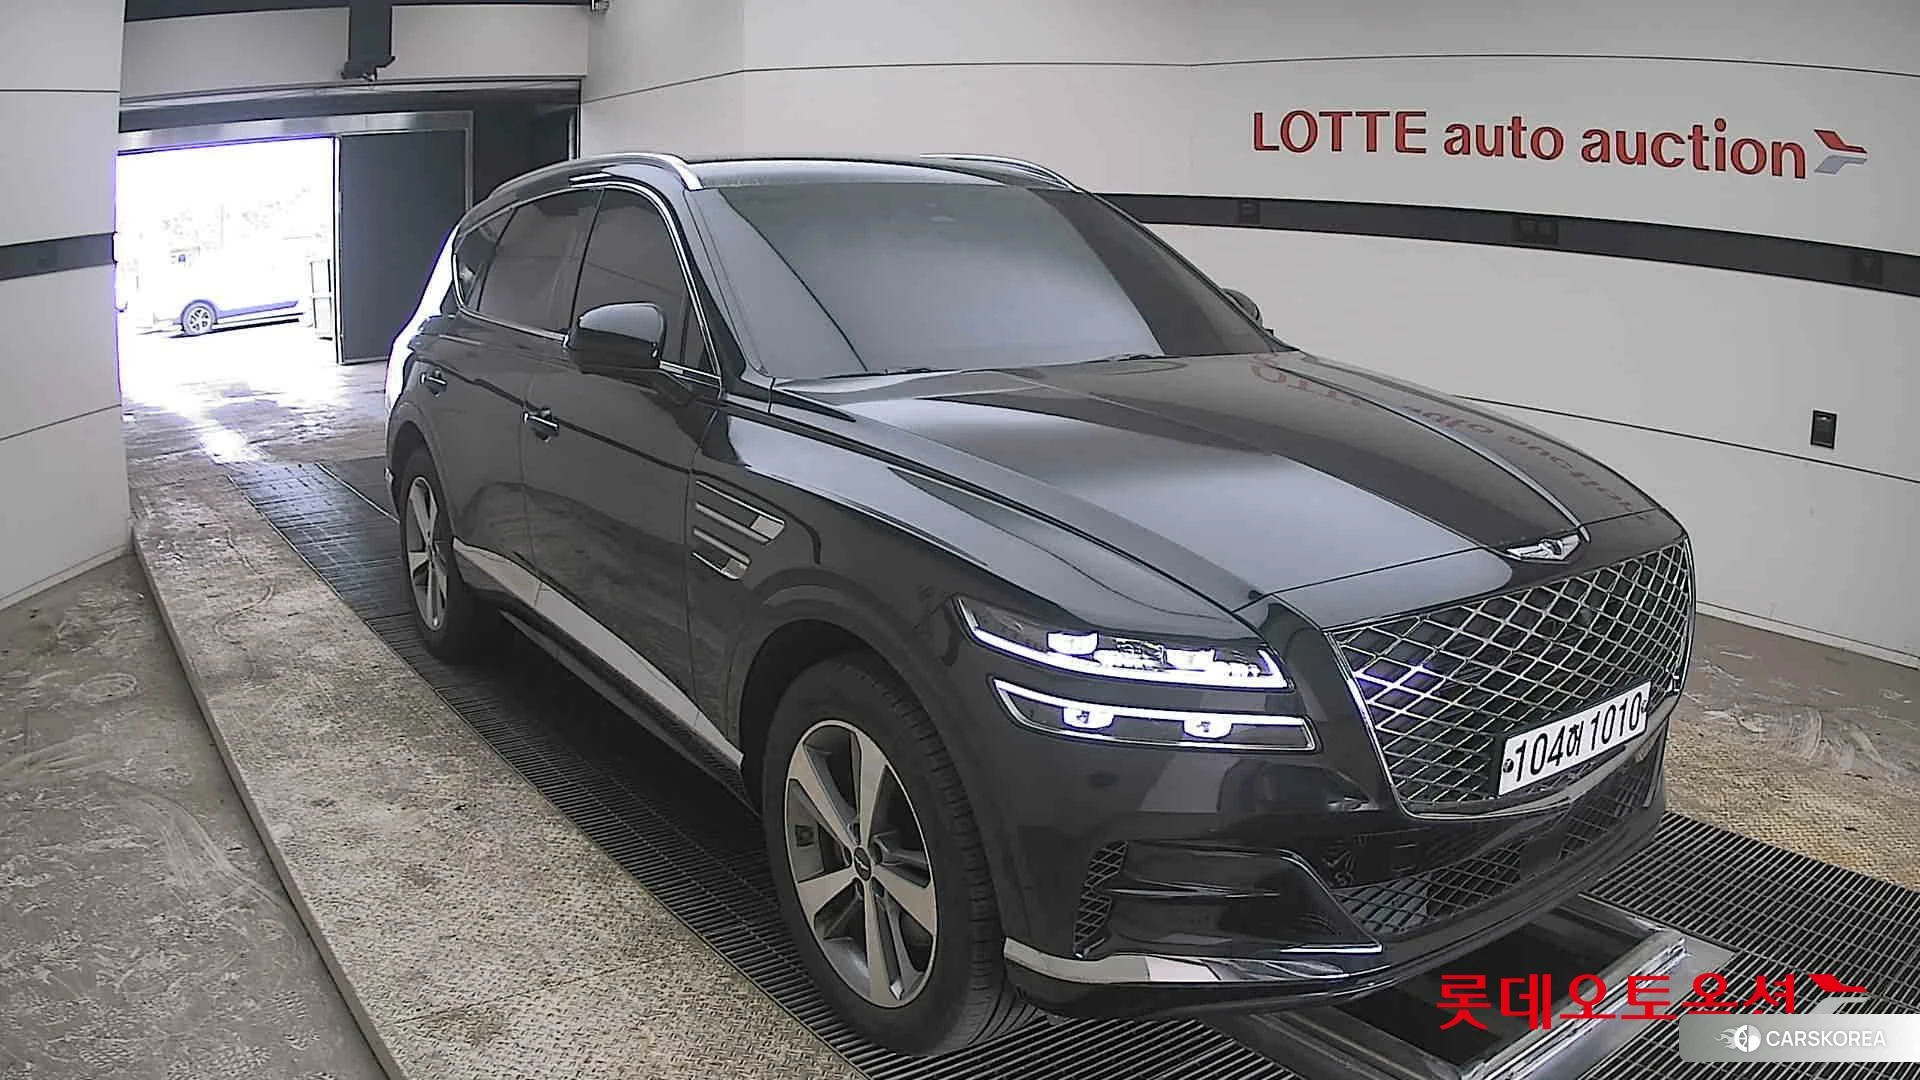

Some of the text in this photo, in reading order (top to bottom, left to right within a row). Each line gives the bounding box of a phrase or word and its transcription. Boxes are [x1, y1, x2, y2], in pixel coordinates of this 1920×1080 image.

[1253, 111, 1807, 179] LOTTE auto auction
[1591, 692, 1643, 751] 1010
